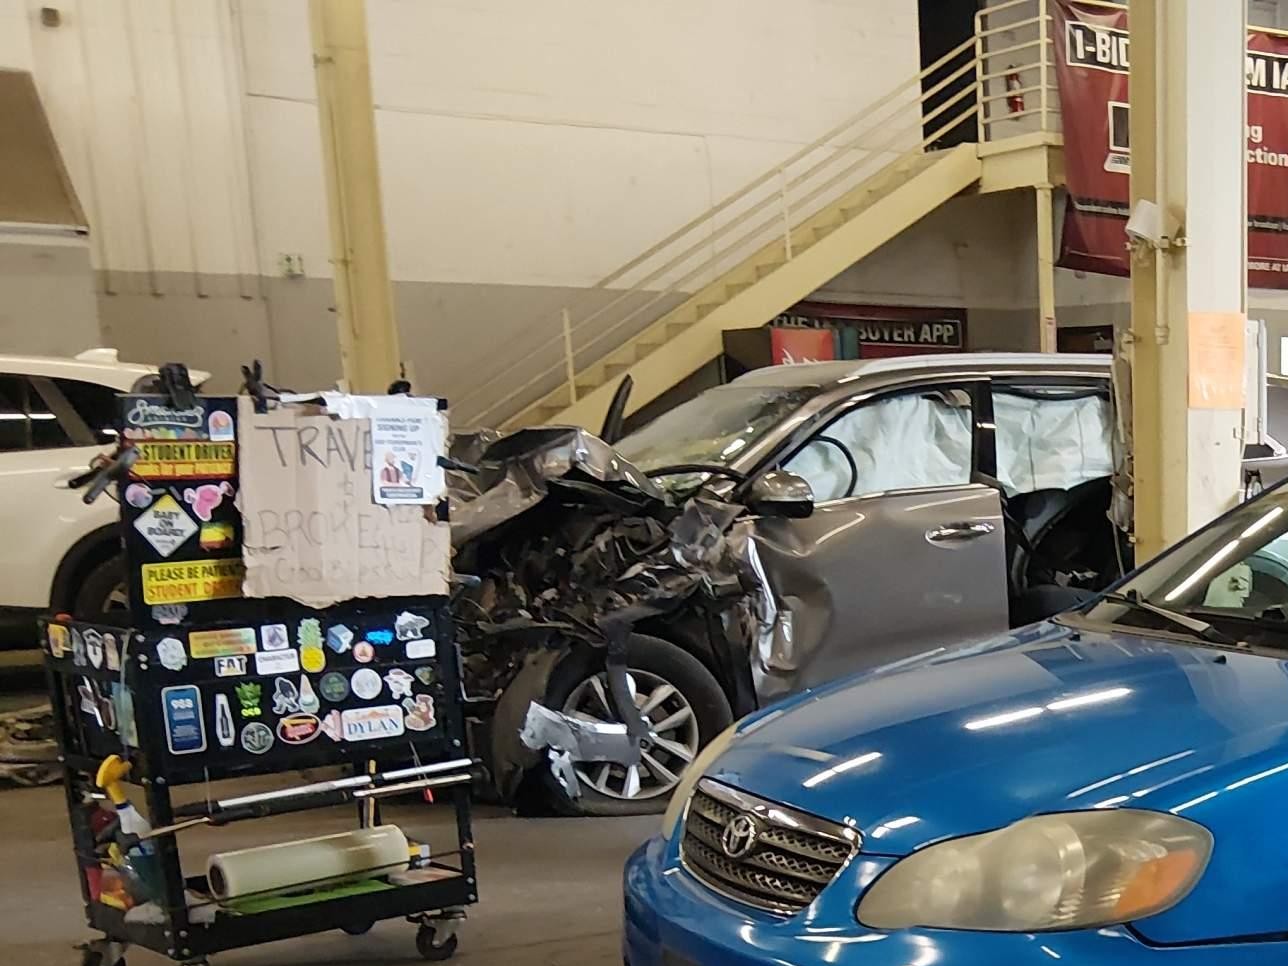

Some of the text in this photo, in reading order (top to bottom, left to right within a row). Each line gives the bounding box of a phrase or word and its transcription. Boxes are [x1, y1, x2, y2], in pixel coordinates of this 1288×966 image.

[919, 323, 954, 343] APP
[143, 444, 232, 461] STUDENT DRIVER
[254, 424, 372, 472] TRAVE
[153, 510, 181, 521] BABY
[158, 518, 174, 528] ON
[147, 567, 186, 582] PLEASE
[187, 565, 199, 579] BE
[148, 581, 197, 600] STUDENT
[216, 657, 246, 675] FAT
[347, 717, 399, 737] DYLAN
